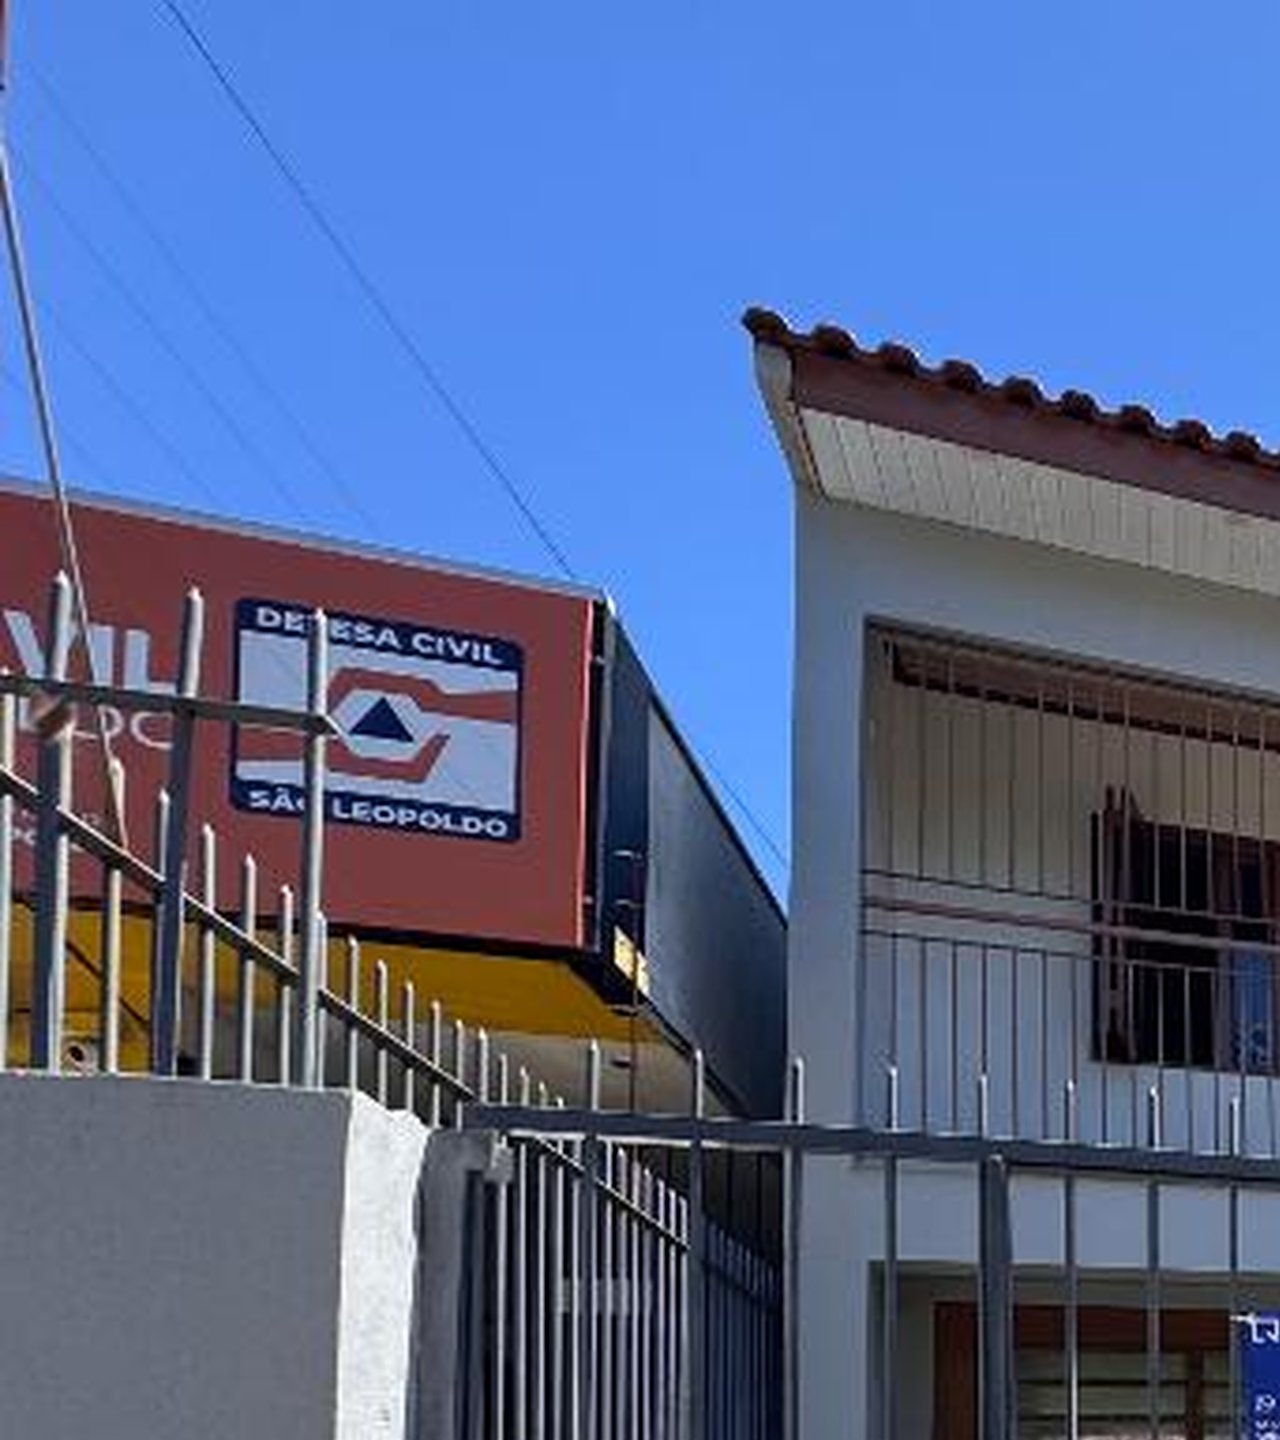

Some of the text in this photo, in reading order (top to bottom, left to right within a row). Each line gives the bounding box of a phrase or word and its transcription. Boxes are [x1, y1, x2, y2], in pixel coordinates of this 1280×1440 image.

[257, 607, 504, 664] DEESA CIVIL
[249, 787, 508, 838] SÃ LEOPOLDO
